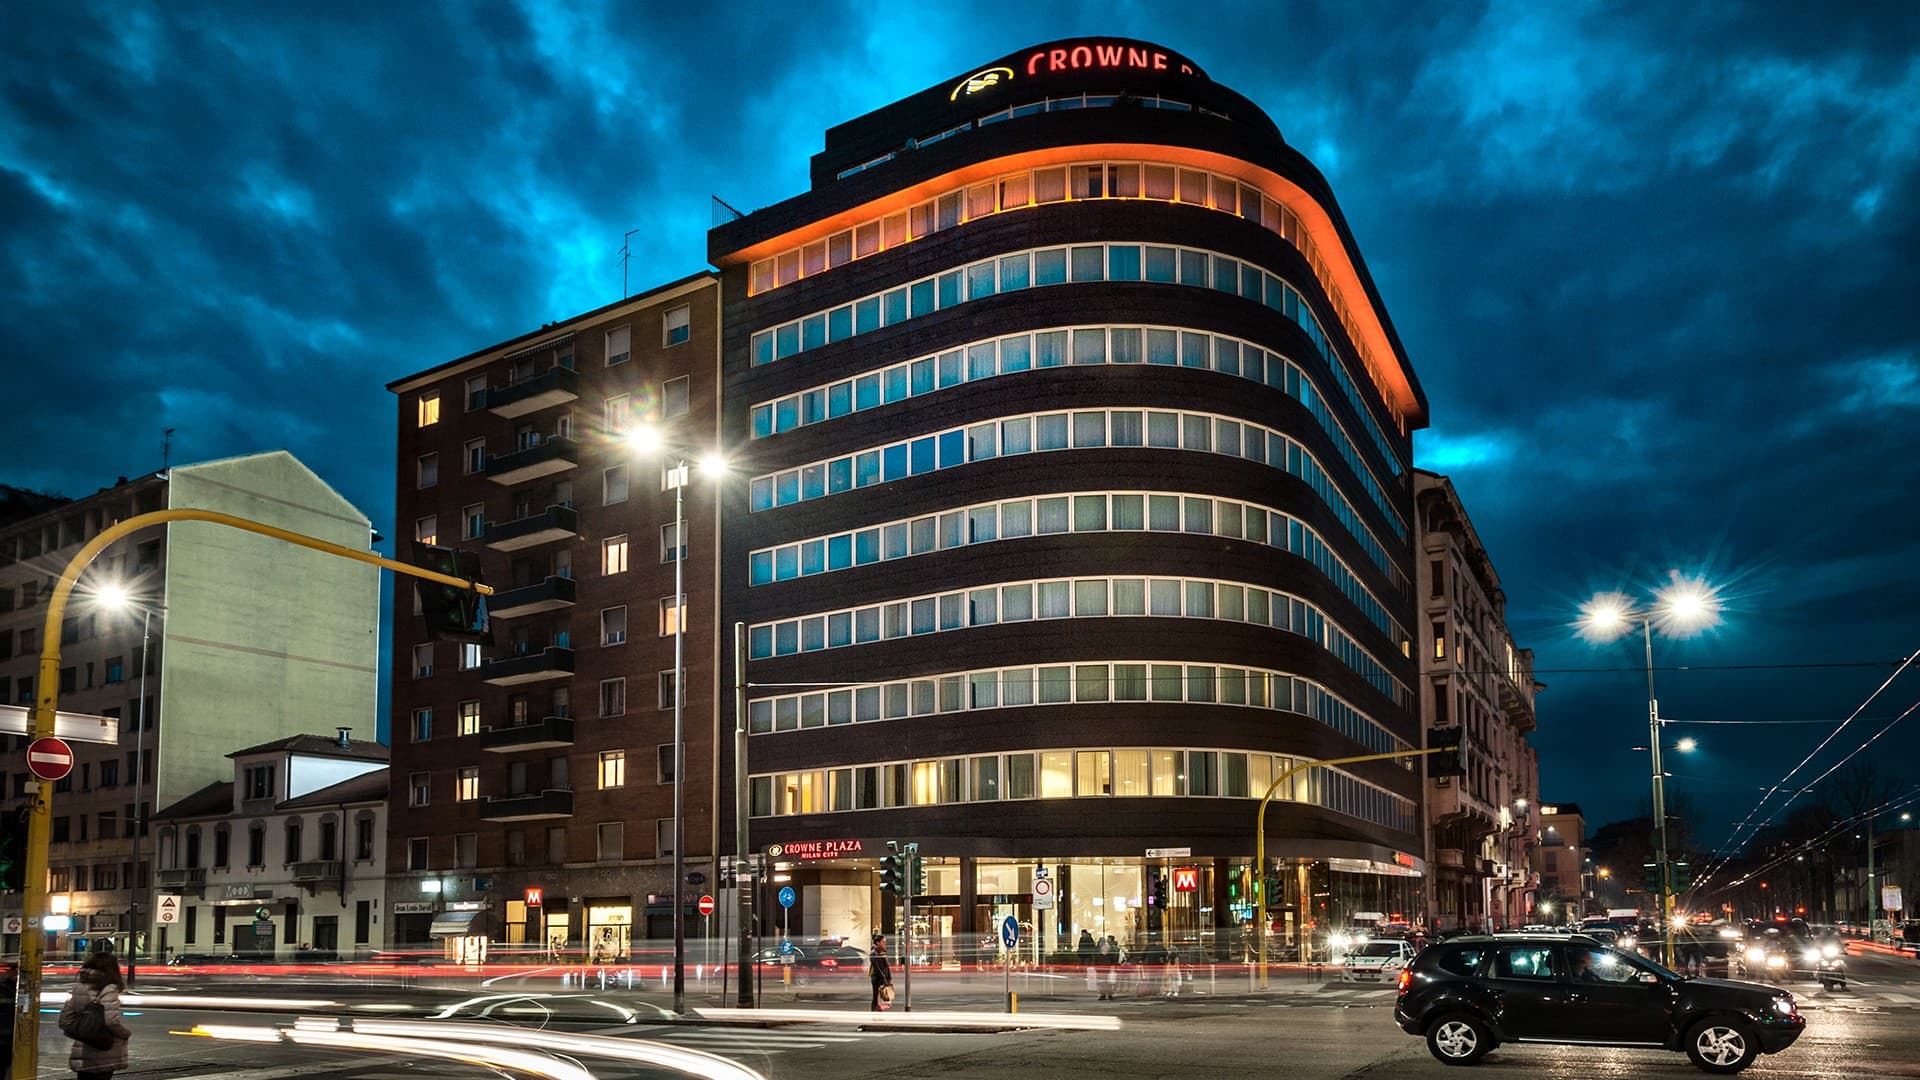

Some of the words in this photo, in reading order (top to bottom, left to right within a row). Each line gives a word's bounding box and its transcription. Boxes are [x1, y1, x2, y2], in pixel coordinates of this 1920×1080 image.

[1027, 45, 1167, 75] CROWNE
[784, 842, 822, 855] CROWNE
[826, 840, 862, 852] PLAZA
[1177, 873, 1196, 888] M
[527, 890, 541, 904] M
